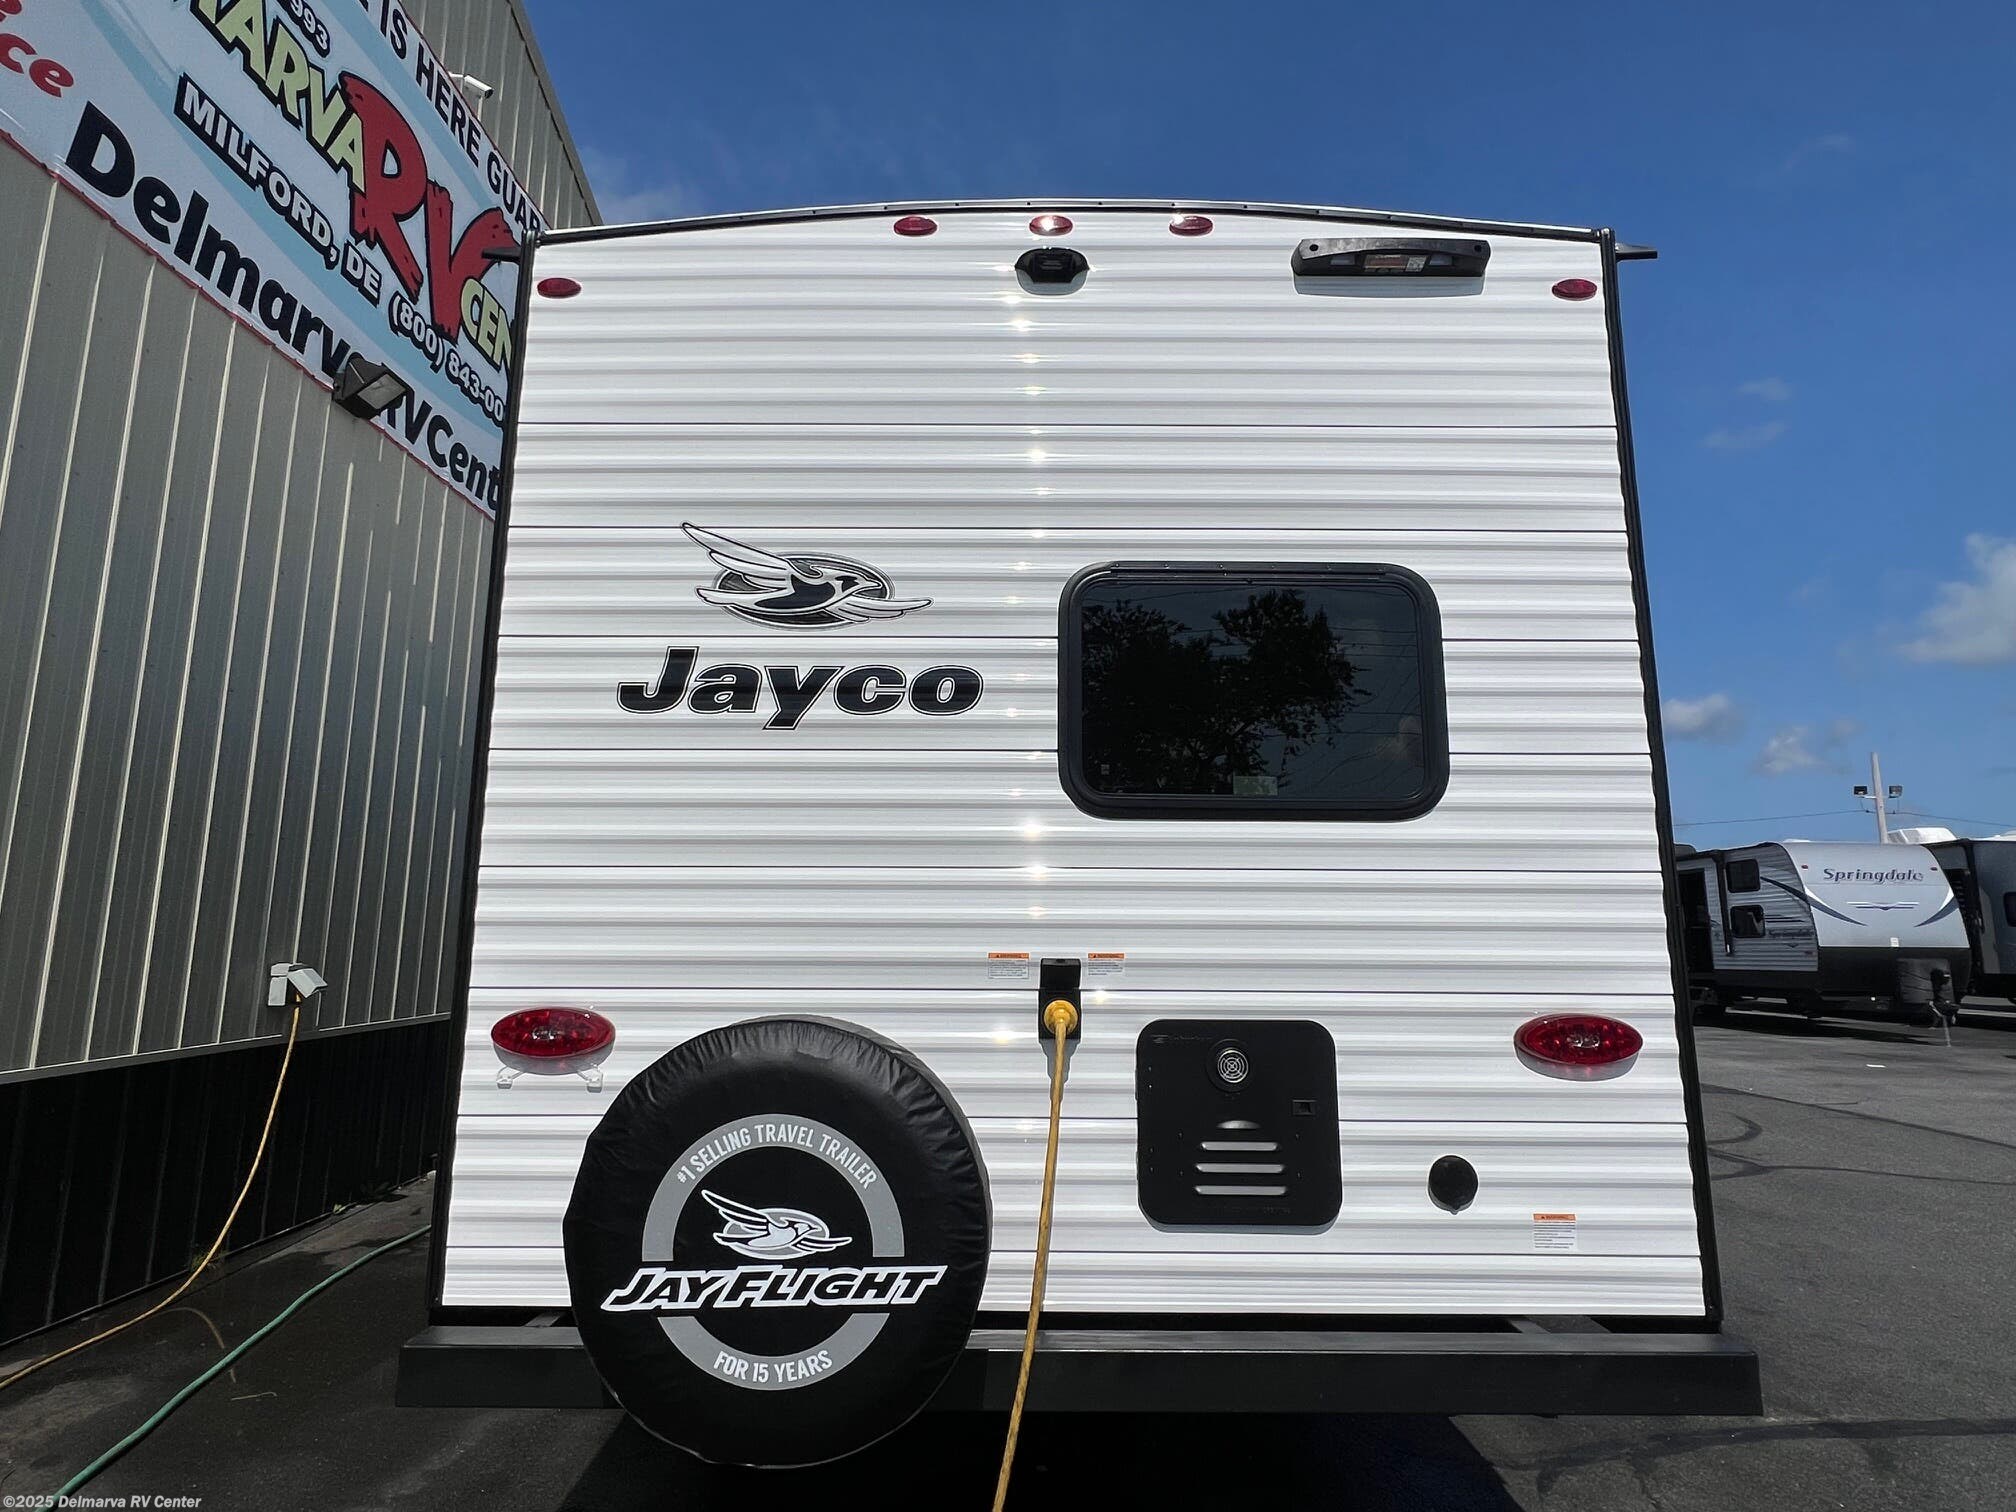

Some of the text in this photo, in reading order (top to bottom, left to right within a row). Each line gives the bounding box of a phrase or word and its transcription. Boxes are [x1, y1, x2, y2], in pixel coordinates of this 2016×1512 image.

[380, 0, 408, 60] IS
[416, 42, 482, 168] HERE
[179, 76, 505, 425] MILFORD, DE (800) 843-00
[616, 645, 984, 731] Jayco
[1822, 867, 1925, 885] Springdale
[676, 1123, 878, 1190] #1 SELLING TRAVEL TRAILER
[713, 1349, 833, 1383] FOR 15 YEARS
